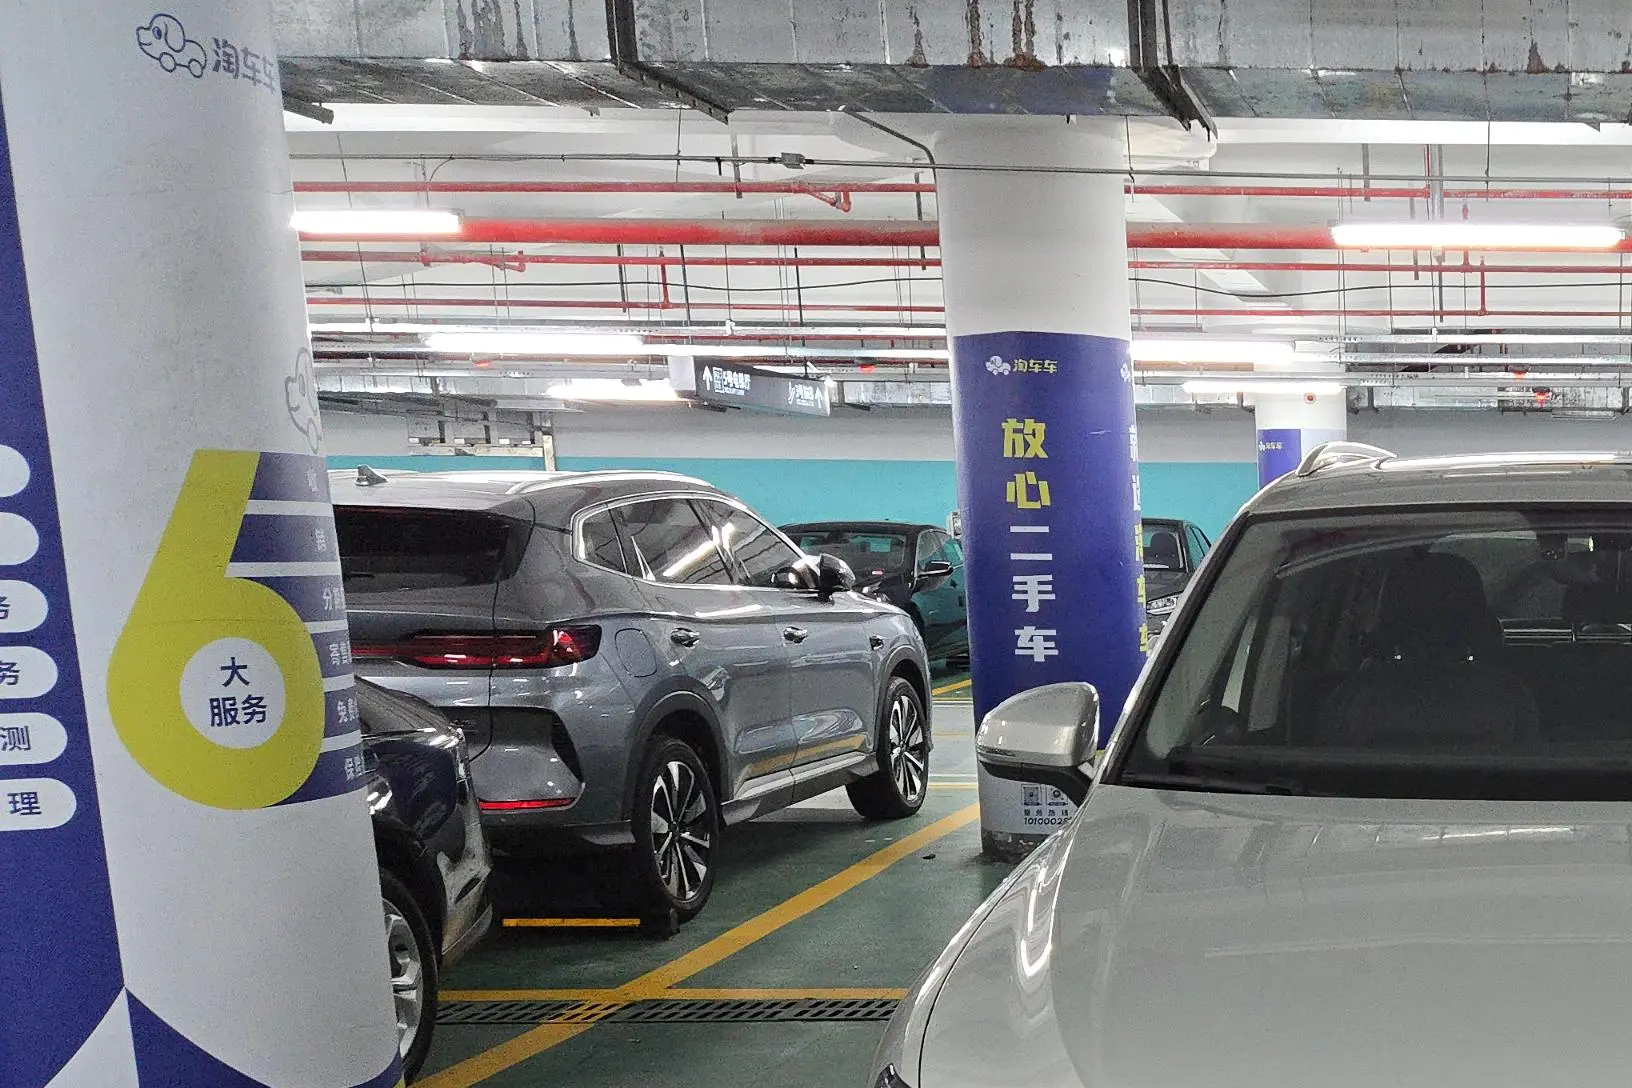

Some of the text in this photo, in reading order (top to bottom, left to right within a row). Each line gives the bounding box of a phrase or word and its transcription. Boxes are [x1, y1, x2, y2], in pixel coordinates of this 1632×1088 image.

[1012, 358, 1058, 374] 淘车车
[1001, 418, 1059, 663] 放心二手车
[220, 656, 251, 688] 大
[209, 694, 268, 728] 服务
[7, 791, 42, 817] 理
